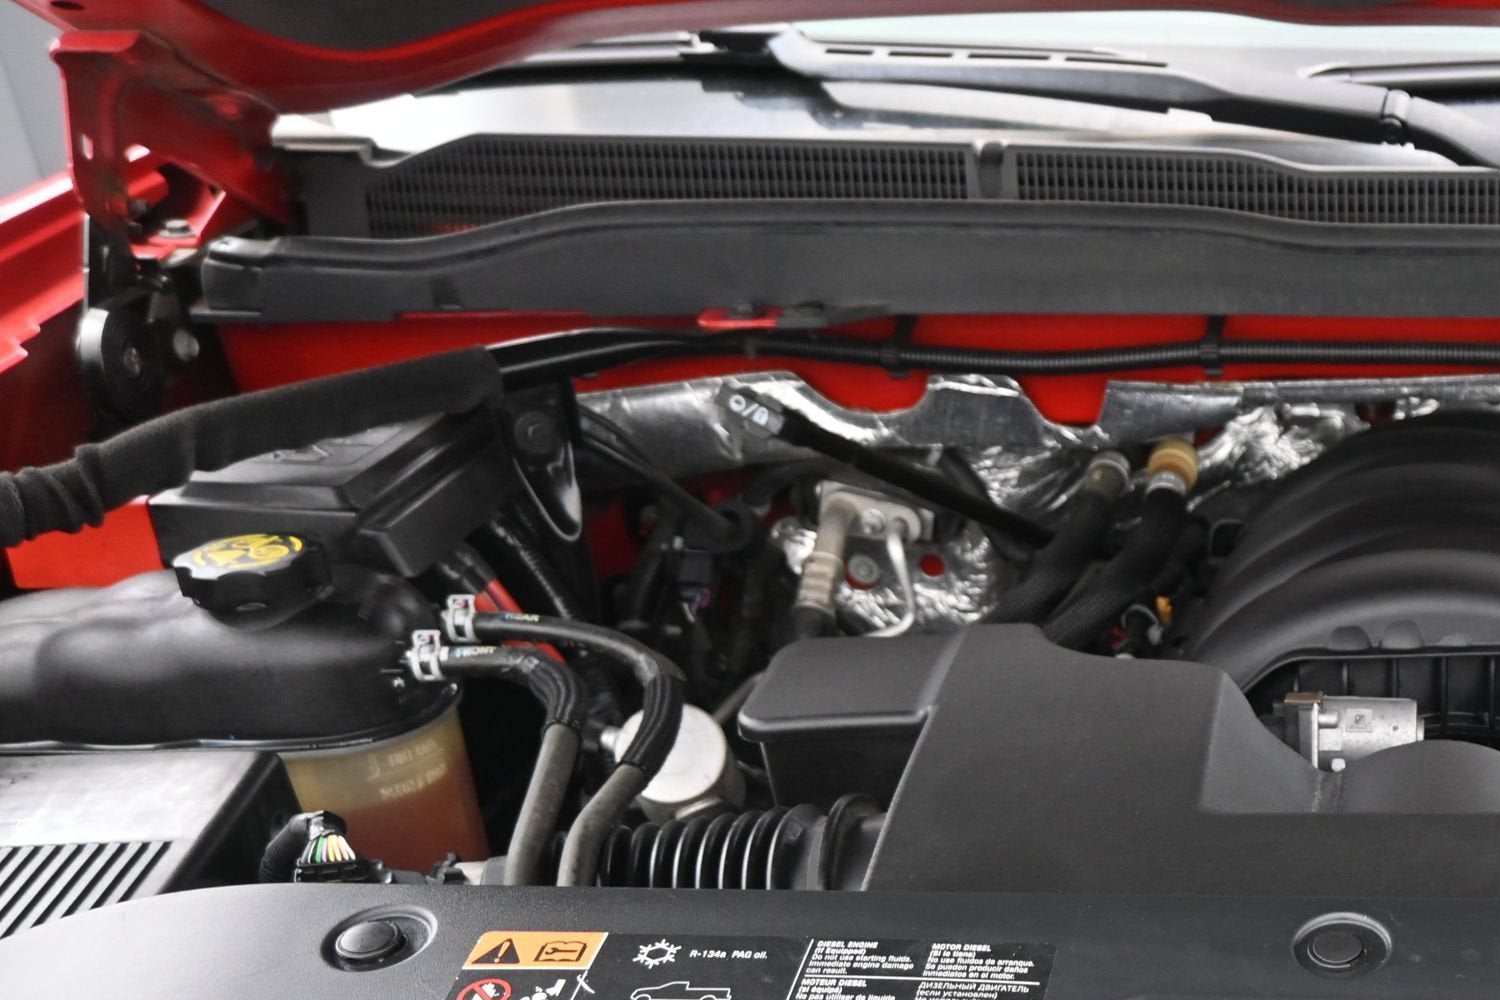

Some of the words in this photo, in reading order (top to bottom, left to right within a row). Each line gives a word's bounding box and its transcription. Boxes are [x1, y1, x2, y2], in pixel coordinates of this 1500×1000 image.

[455, 646, 497, 658] FRONT
[848, 941, 879, 949] ENGINE
[932, 943, 962, 951] MOTOR
[963, 944, 992, 952] DIESEL
[690, 950, 727, 959] R-134a
[732, 950, 752, 959] PAG
[754, 950, 768, 959] oil.
[853, 961, 880, 969] engine
[969, 965, 1003, 973] producir
[801, 979, 837, 987] MOTEUR
[919, 982, 977, 990] ДИЗЕЛЬНЫЙ
[978, 984, 1030, 993] ДВИГАТЕЛЬ
[826, 993, 854, 1000] utiliser
[916, 989, 941, 997] (если
[943, 990, 998, 999] установлен)
